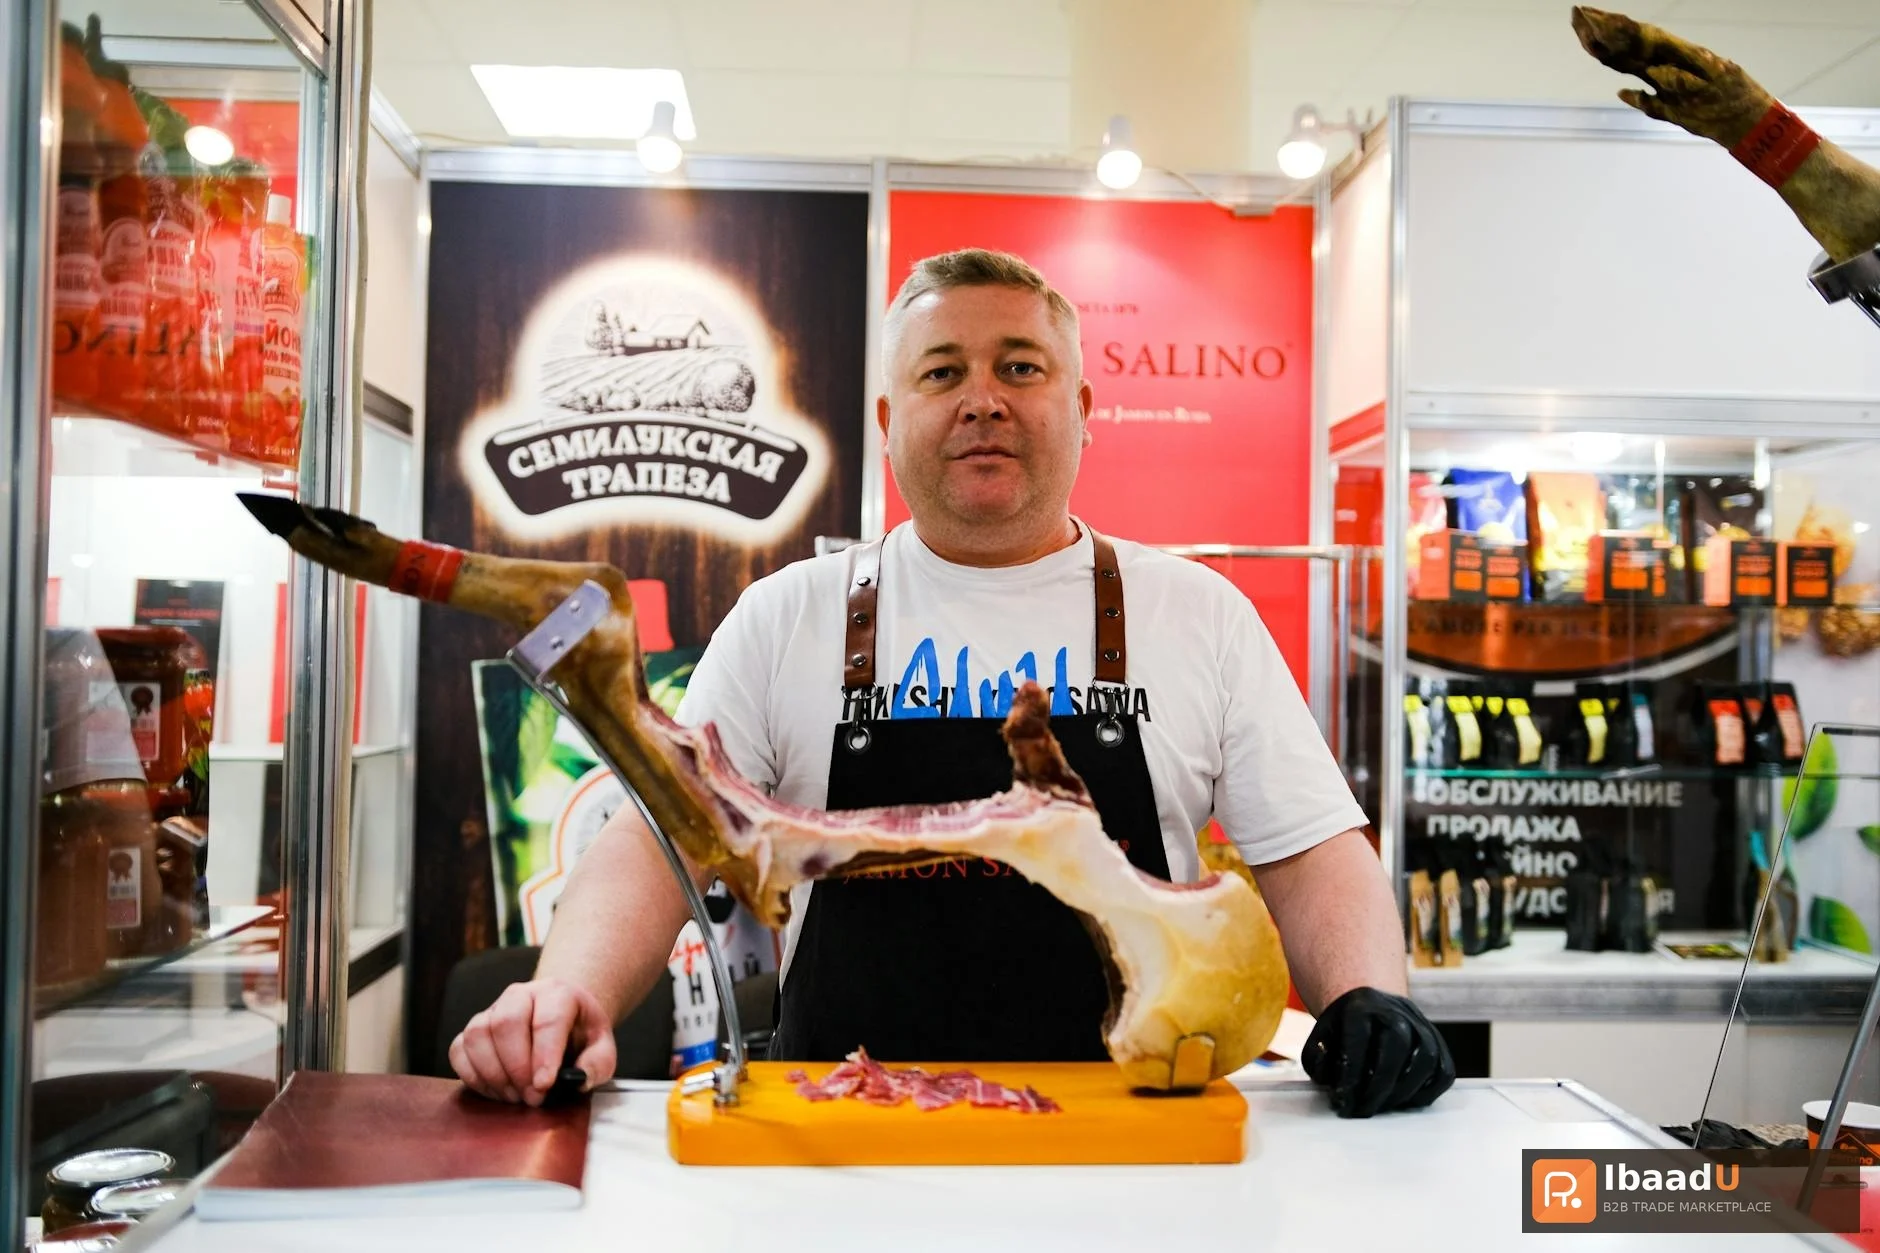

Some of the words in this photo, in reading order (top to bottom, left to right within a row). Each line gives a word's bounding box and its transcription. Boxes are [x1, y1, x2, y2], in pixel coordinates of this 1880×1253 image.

[1103, 341, 1287, 381] SALINO
[508, 424, 784, 483] СЕМИЛУКСКАЯ
[562, 461, 732, 503] ТРАПЕЗА
